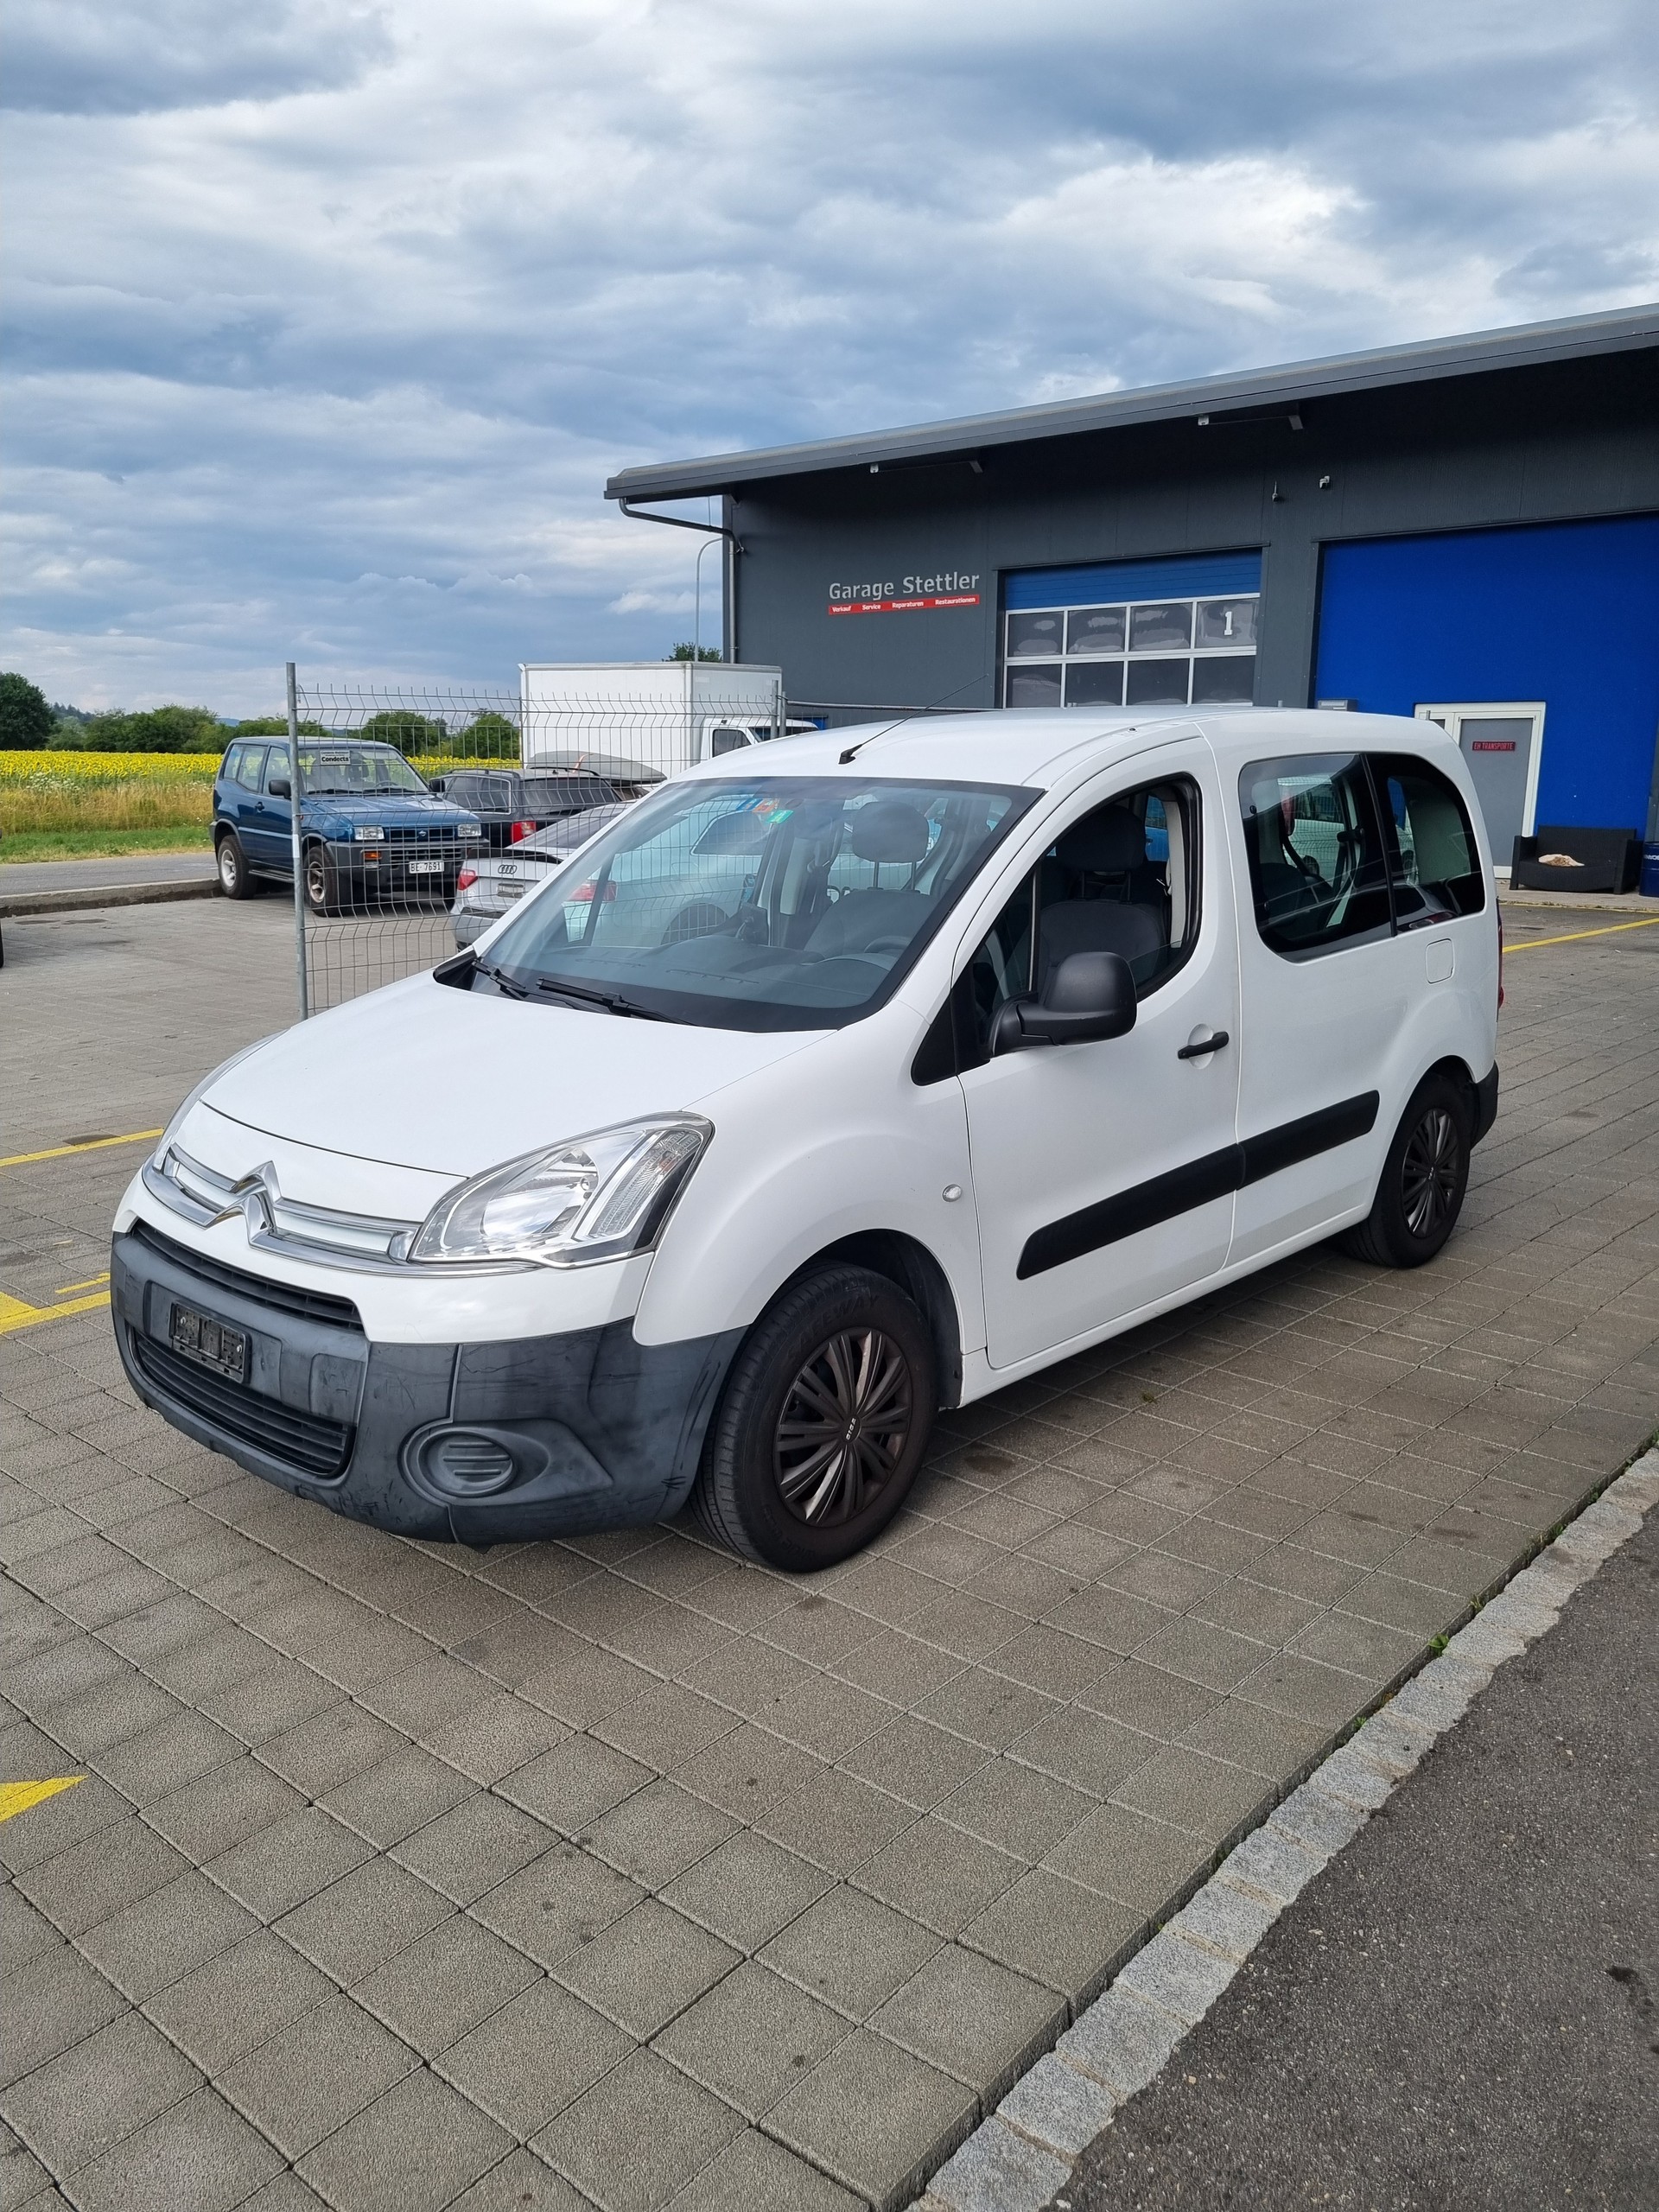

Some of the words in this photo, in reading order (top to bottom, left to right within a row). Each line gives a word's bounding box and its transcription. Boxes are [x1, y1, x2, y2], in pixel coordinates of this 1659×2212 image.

[829, 582, 894, 601] Garage
[902, 571, 980, 594] Stettler
[892, 601, 925, 609] Reparaturen
[935, 597, 976, 606] Restaurationen
[1224, 611, 1233, 636] 1
